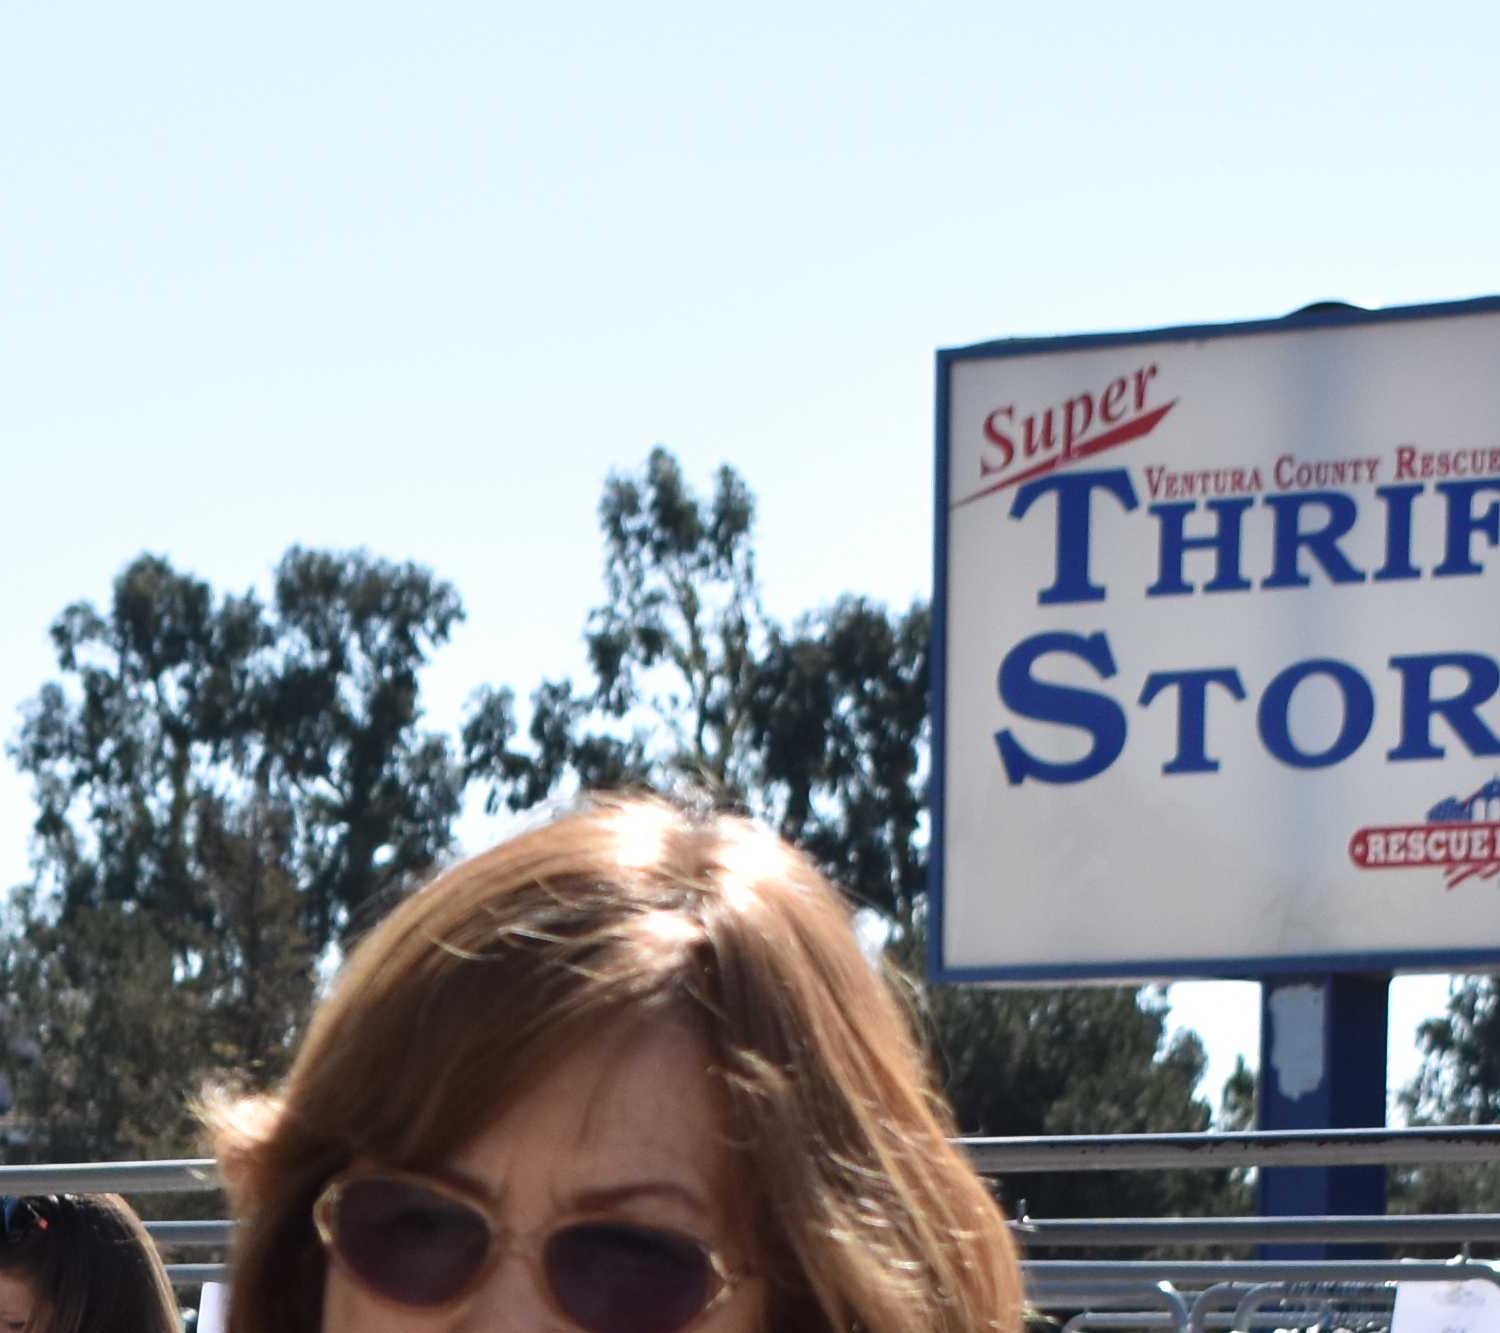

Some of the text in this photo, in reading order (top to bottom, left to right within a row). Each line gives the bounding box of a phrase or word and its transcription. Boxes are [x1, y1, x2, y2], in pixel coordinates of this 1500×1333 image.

[979, 361, 1159, 478] Super
[1143, 464, 1264, 499] VENTURA
[1272, 453, 1380, 491] COUNTY
[1364, 827, 1491, 865] RESCUE
